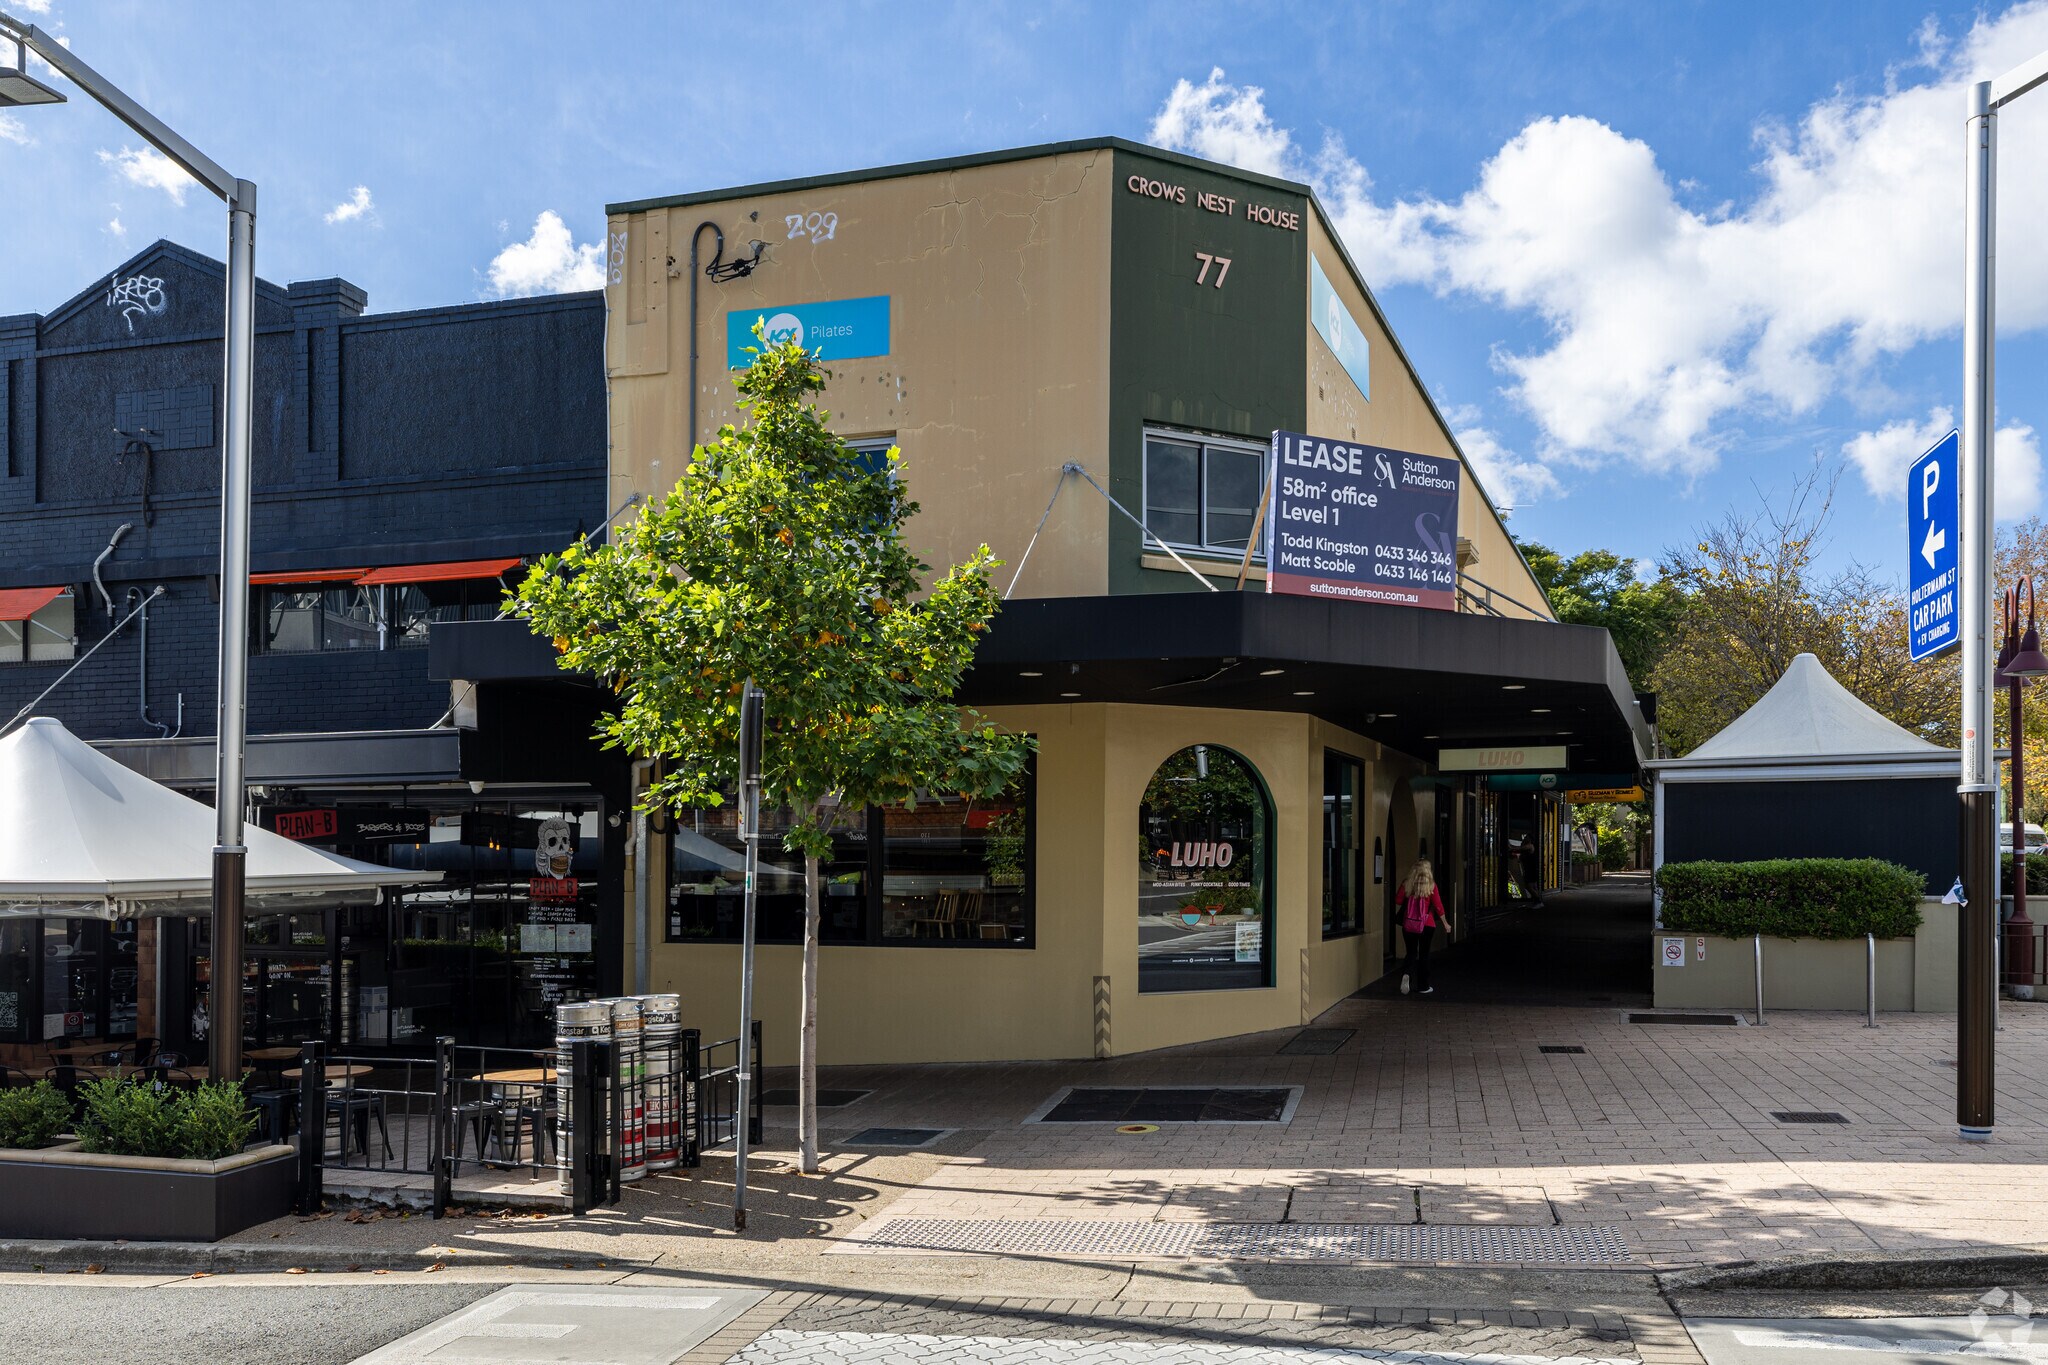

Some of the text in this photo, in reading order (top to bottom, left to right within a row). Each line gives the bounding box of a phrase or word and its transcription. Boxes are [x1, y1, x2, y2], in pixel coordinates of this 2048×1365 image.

[1127, 175, 1300, 231] CROWS NEST HOUSE
[1195, 252, 1232, 289] 77
[811, 323, 853, 339] Pilates
[1284, 437, 1363, 476] LEASE
[1402, 457, 1438, 475] Sutton
[1402, 471, 1456, 491] Anderson
[1923, 460, 1940, 521] P
[1331, 485, 1378, 508] office
[1282, 500, 1340, 526] Level 1
[1281, 532, 1452, 566] Todd Kingston 0433 346 346
[1281, 552, 1452, 584] Matt Scoble 0433 146 146
[1947, 567, 1956, 585] ST
[1310, 583, 1419, 603] suttonanderson.com.au
[1913, 590, 1953, 632] CAR PARK
[1921, 632, 1927, 646] EV
[279, 812, 333, 838] PLAN-B
[1170, 841, 1233, 868] LUHO
[532, 880, 574, 895] PLAN-B
[1697, 938, 1704, 959] S V
